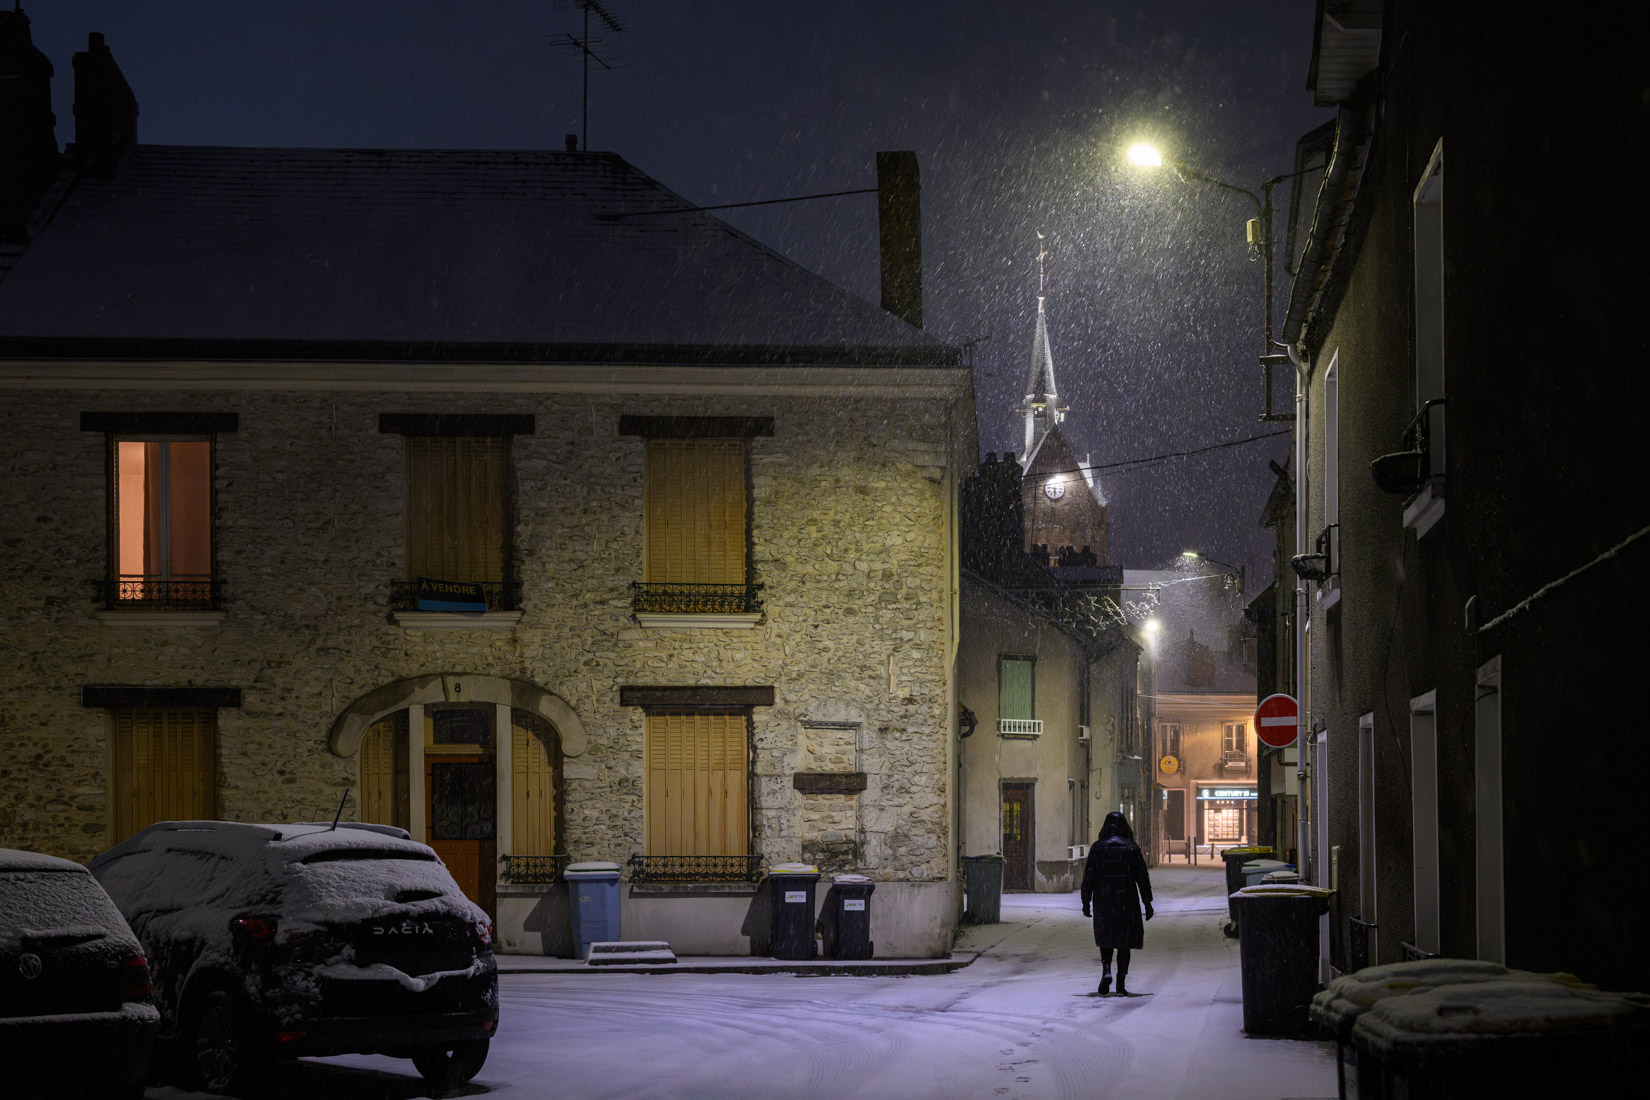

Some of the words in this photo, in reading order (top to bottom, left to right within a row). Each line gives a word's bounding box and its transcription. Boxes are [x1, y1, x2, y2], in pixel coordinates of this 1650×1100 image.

[431, 581, 478, 595] VENDRE
[454, 682, 461, 693] 8
[1214, 789, 1243, 797] CENTURY
[373, 924, 434, 935] DACIA
